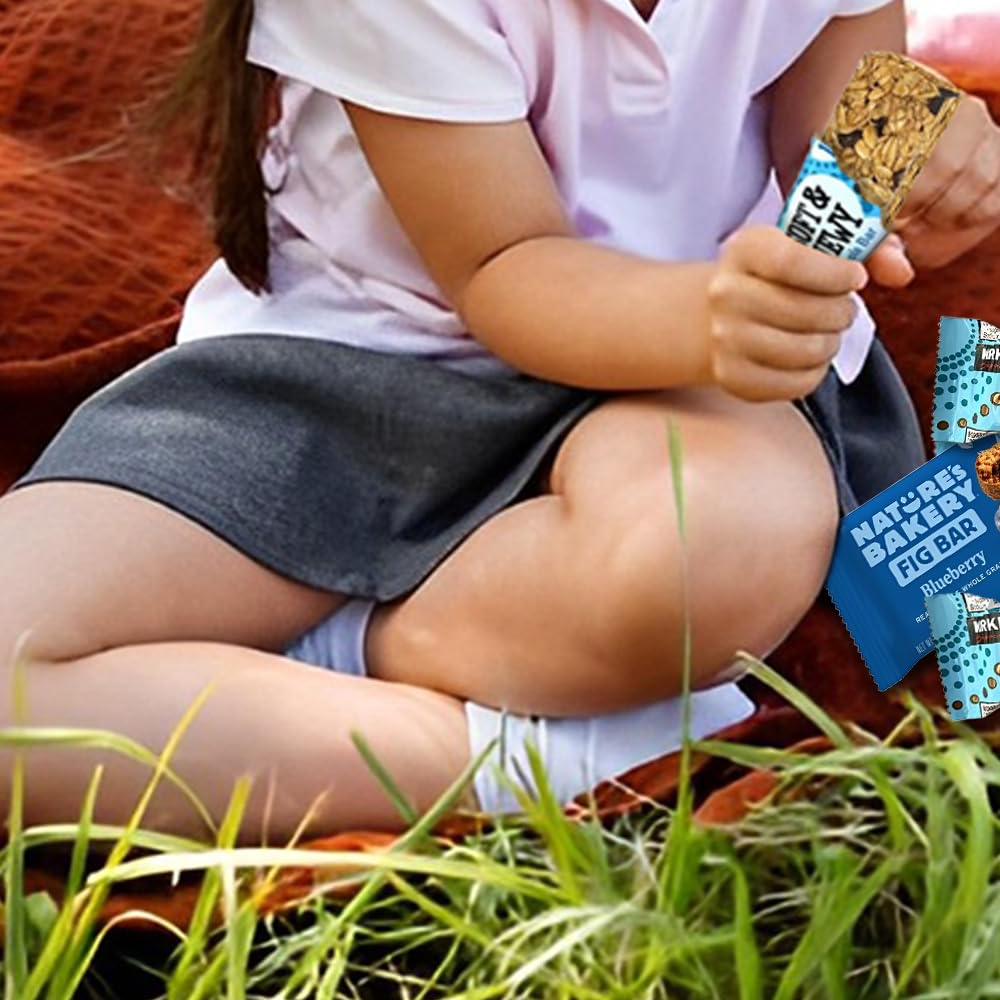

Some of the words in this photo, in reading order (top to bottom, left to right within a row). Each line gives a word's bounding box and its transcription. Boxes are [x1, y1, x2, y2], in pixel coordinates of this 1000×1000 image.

[802, 185, 831, 210] &
[786, 203, 821, 243] OFT
[813, 202, 864, 256] EWY
[861, 479, 977, 568] BAKERY
[896, 545, 934, 579] FIG
[933, 517, 978, 554] BAR
[919, 549, 987, 598] Blueberry
[961, 573, 986, 592] WHOLE
